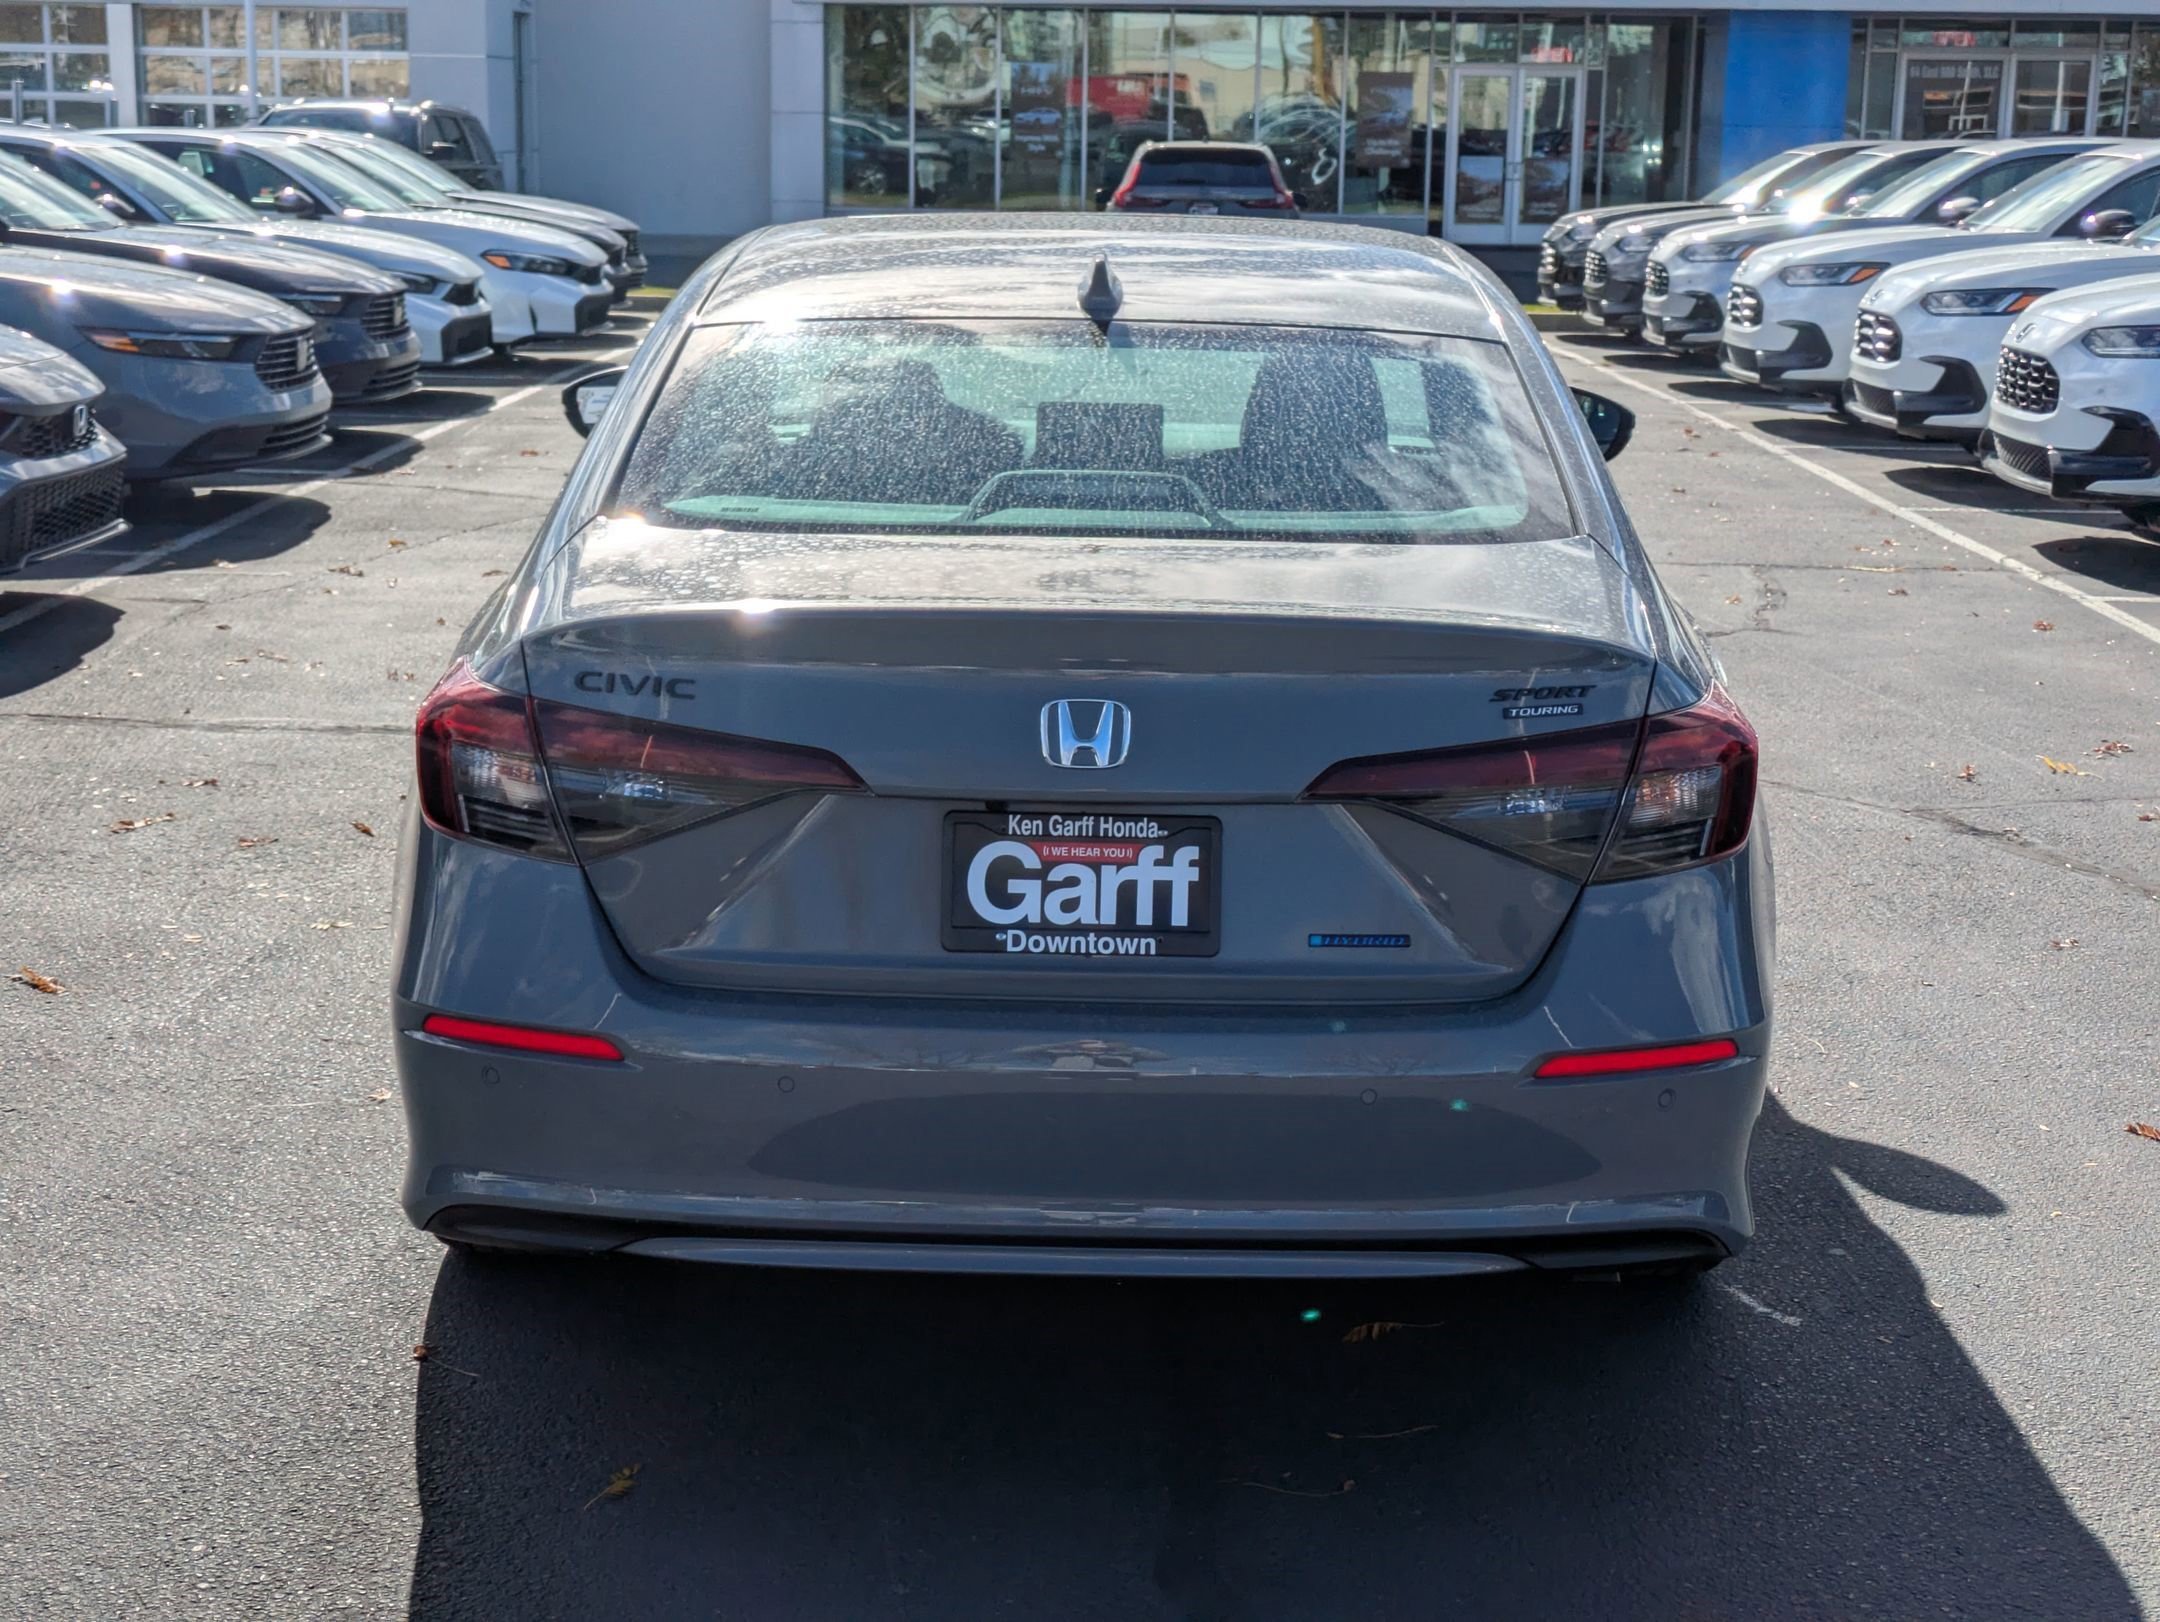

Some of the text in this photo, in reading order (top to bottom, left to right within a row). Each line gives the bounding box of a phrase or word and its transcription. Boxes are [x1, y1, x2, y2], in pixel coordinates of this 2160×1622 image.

[574, 671, 696, 700] CIVIC
[1489, 684, 1598, 702] SPORT
[1508, 705, 1579, 717] TOURING
[1007, 814, 1159, 839] Ken Garff Honda
[1051, 846, 1126, 858] WE HEAR YOU
[966, 840, 1200, 927] Garff
[1006, 929, 1157, 956] Downtown
